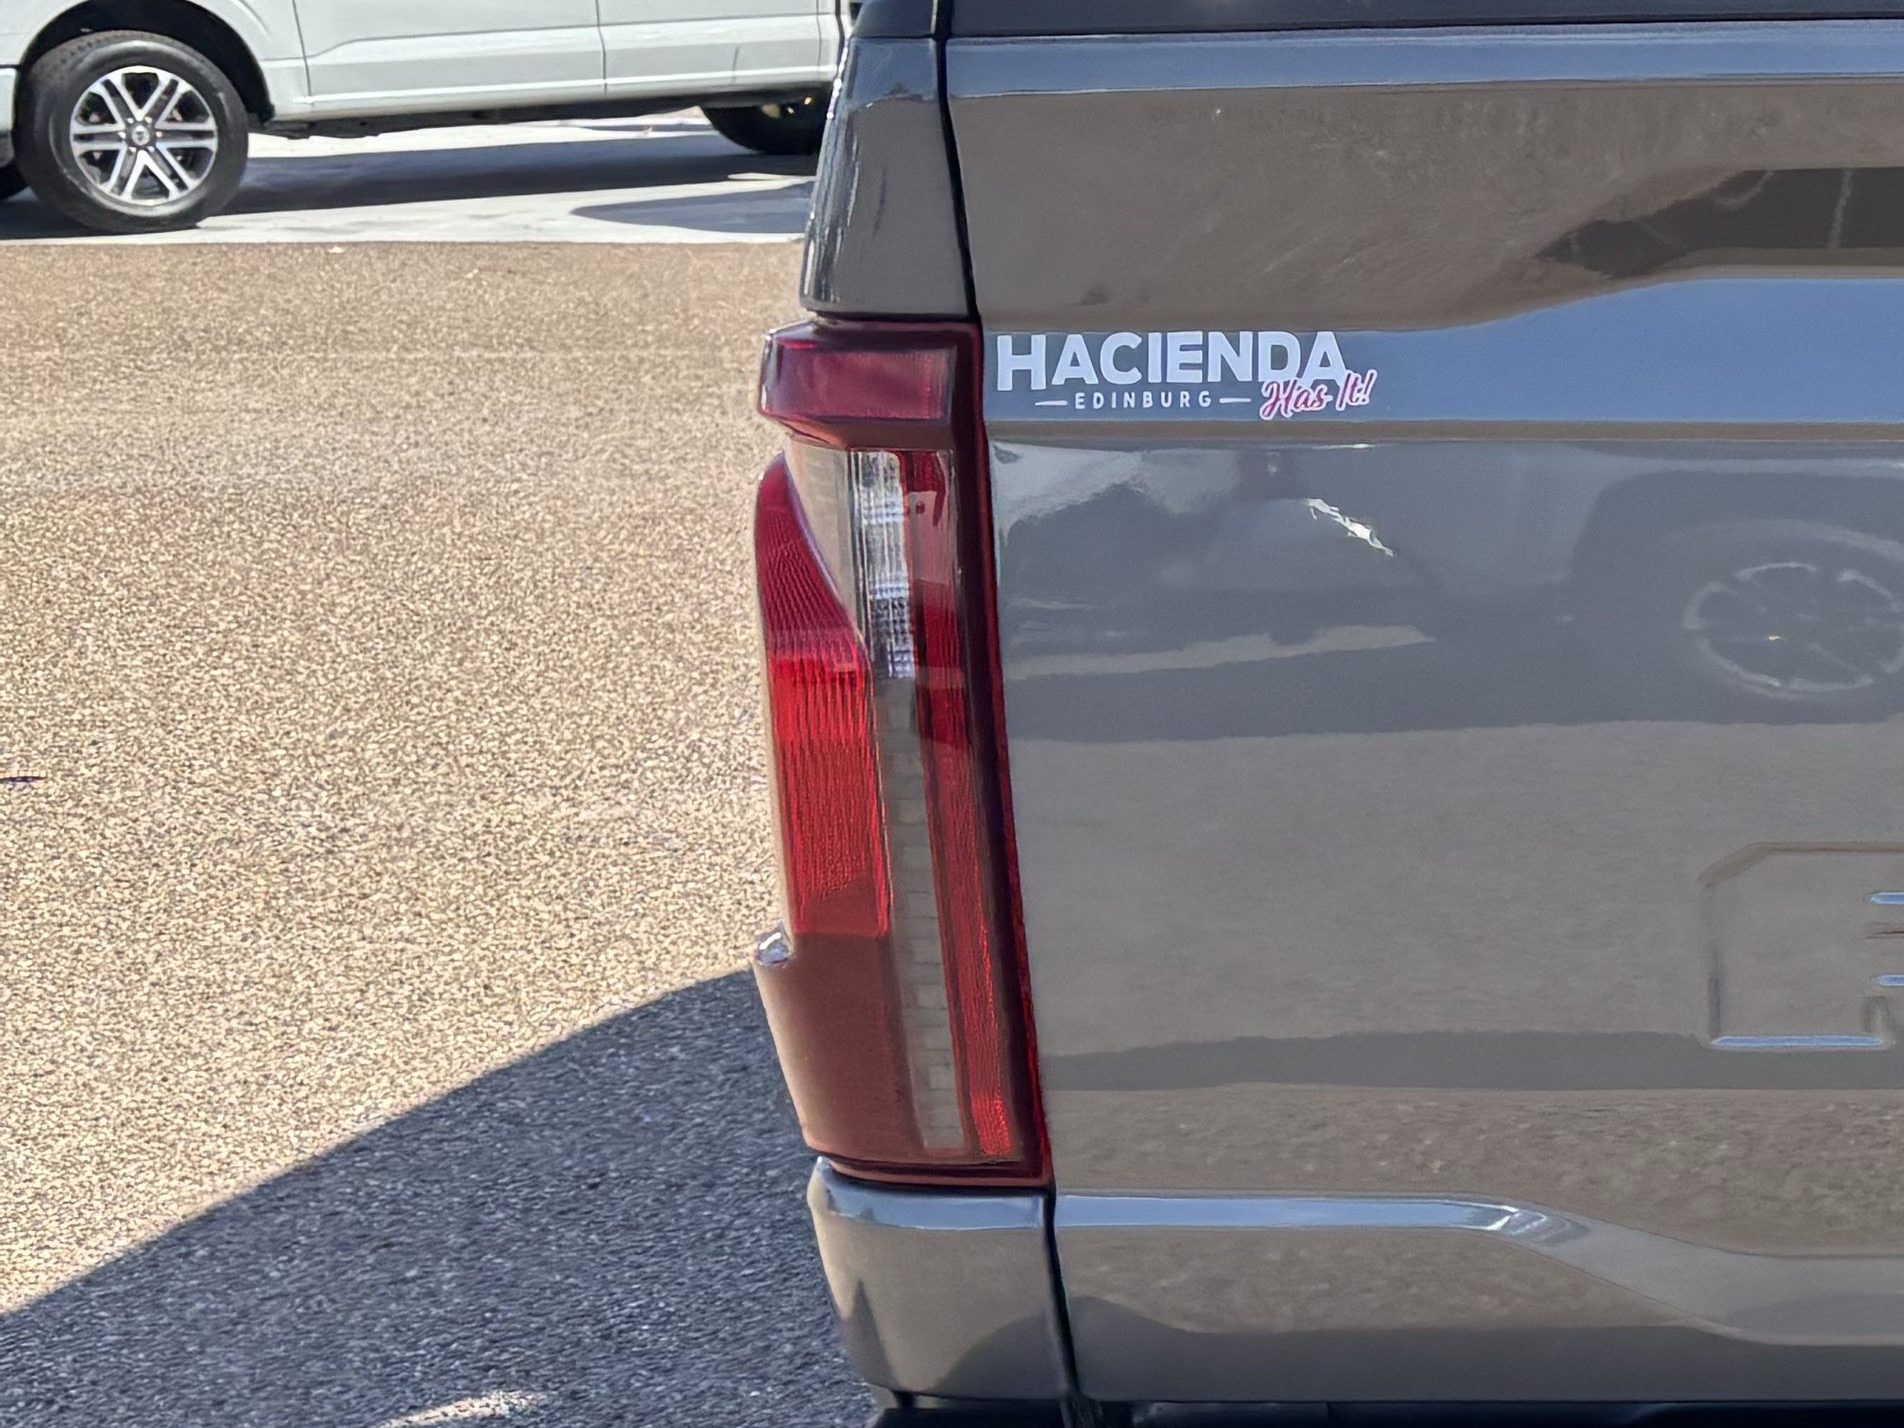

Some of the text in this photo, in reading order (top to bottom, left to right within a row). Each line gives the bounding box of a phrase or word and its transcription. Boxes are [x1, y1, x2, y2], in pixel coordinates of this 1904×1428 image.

[996, 330, 1349, 391] HACIENDA
[1074, 390, 1213, 410] EDINBURG
[1260, 370, 1377, 421] Has It!
